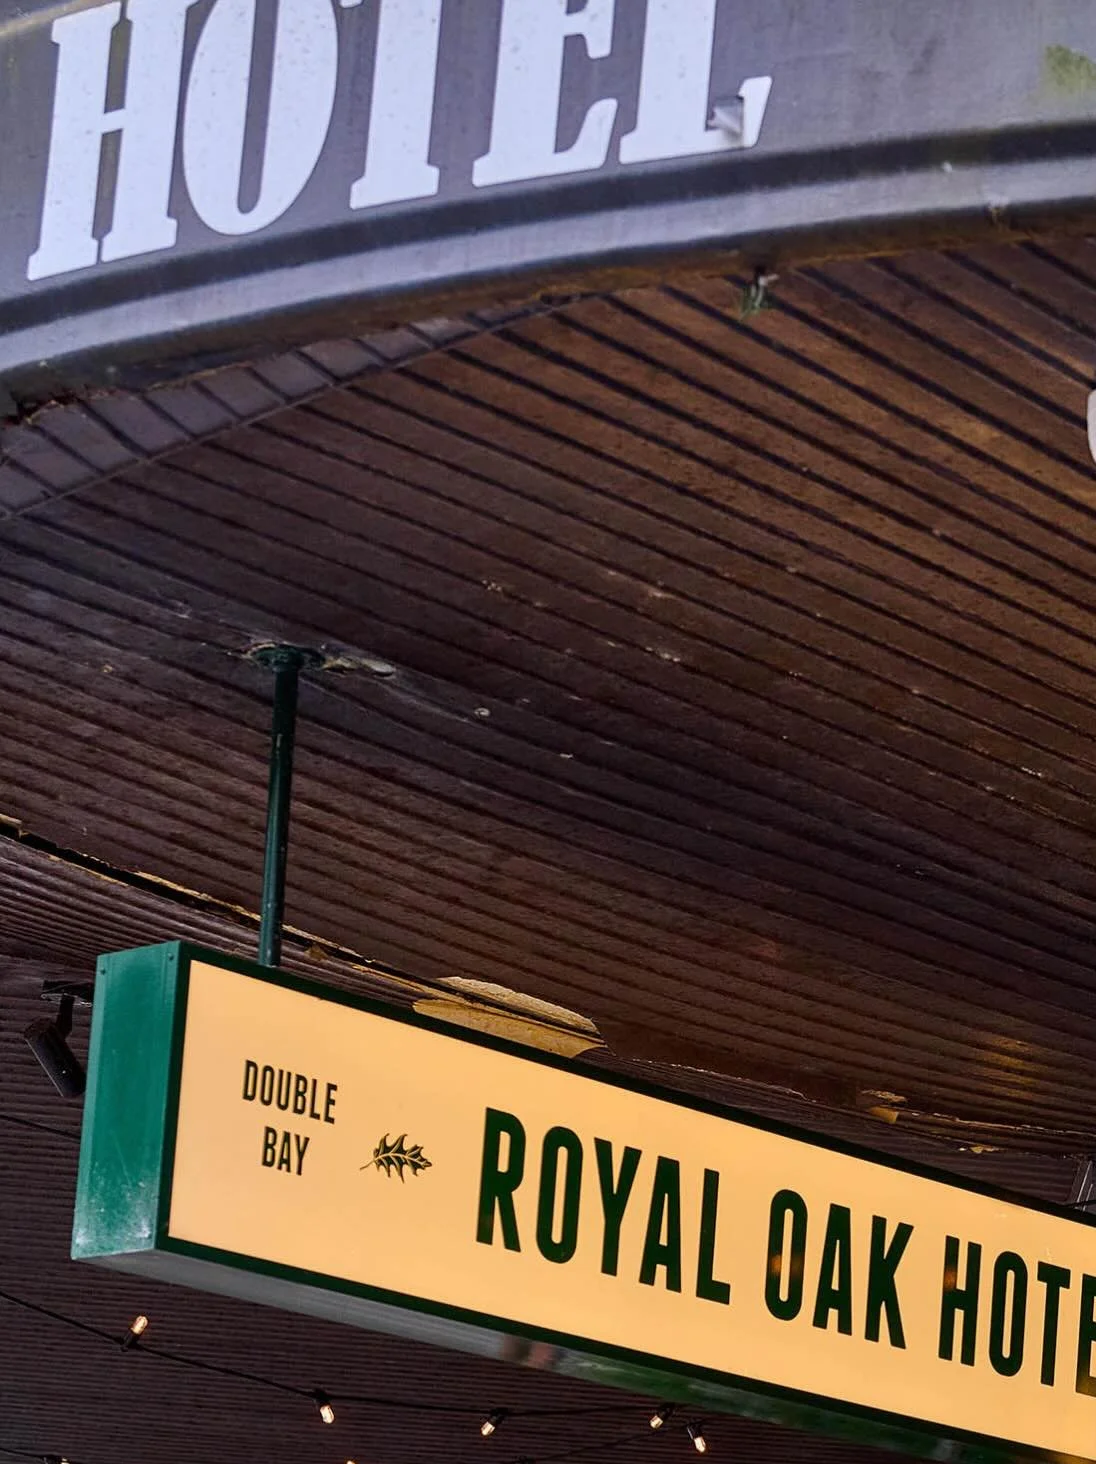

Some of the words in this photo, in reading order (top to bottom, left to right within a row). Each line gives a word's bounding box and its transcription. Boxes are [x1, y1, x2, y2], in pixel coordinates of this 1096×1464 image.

[27, 0, 773, 280] HOTEL
[242, 1059, 338, 1125] DOUBLE
[261, 1125, 311, 1177] BAY
[475, 1106, 731, 1305] ROYAL
[764, 1188, 914, 1350] OAK
